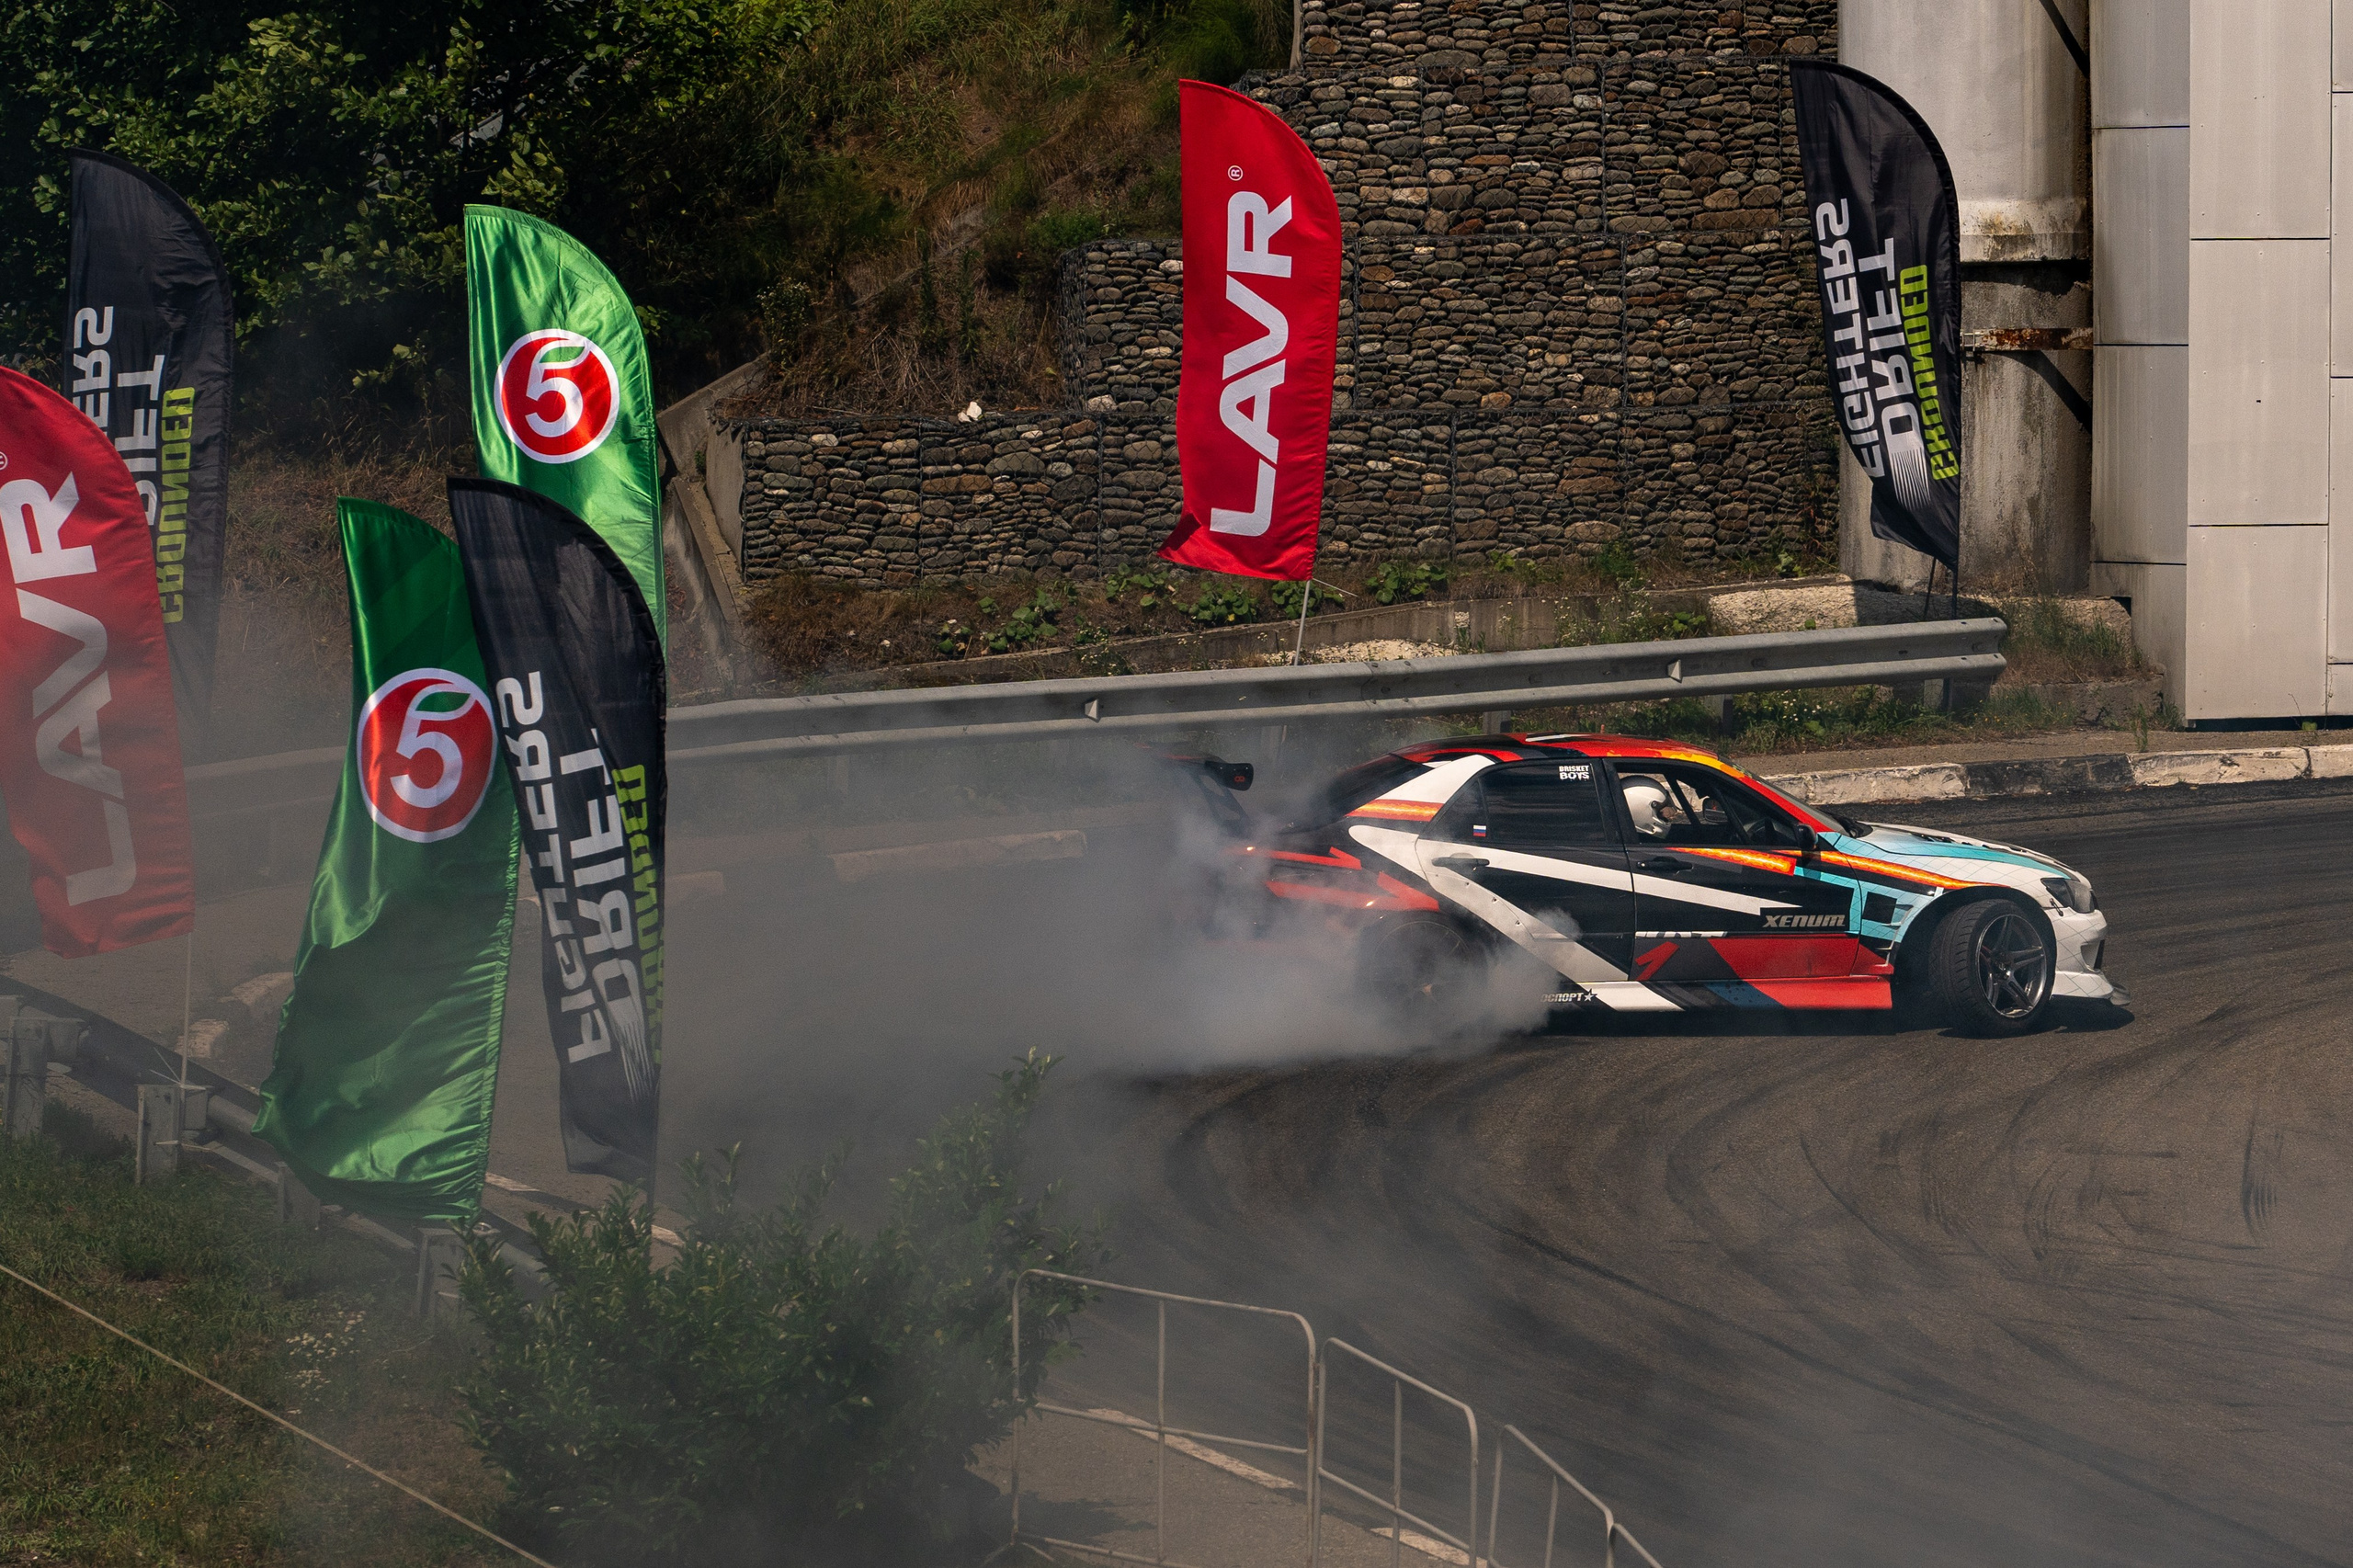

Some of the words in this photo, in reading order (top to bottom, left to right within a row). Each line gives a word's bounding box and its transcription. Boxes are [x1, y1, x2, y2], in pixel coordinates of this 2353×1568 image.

[525, 340, 587, 437] 5
[1210, 191, 1292, 537] LAVR
[0, 471, 137, 906] LAVR
[390, 684, 472, 808] 5
[1559, 771, 1590, 780] BOYS
[1540, 992, 1585, 1003] ОСПОРТ
